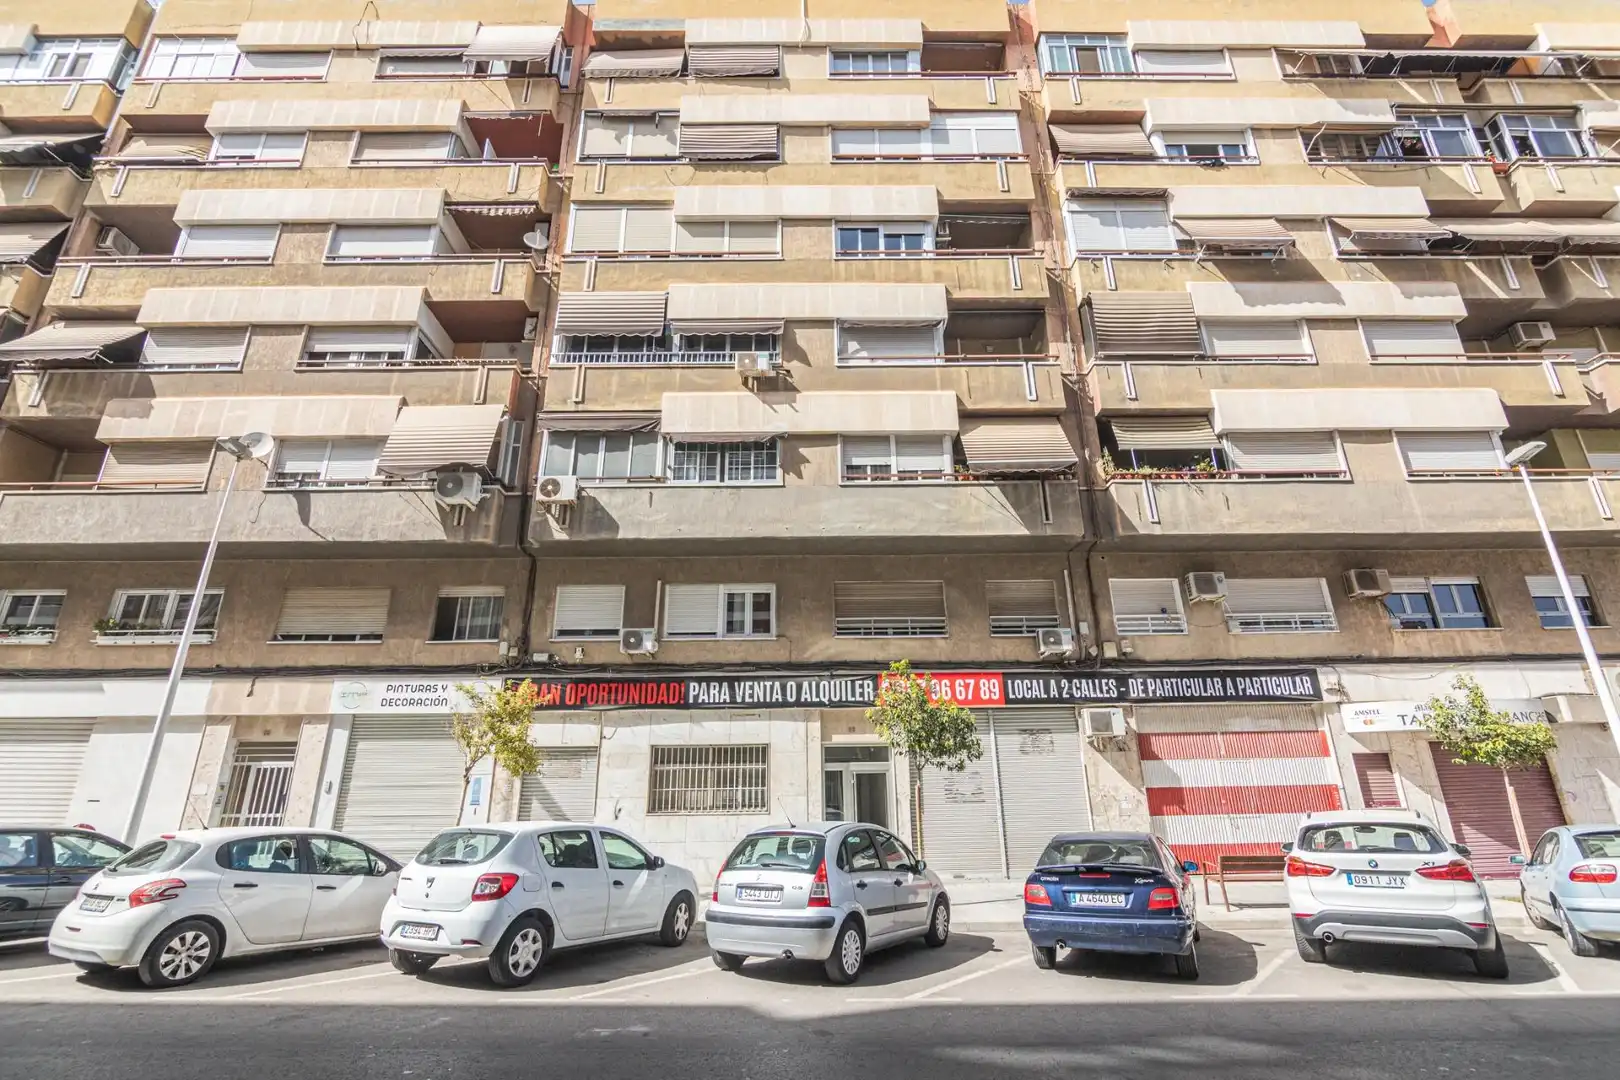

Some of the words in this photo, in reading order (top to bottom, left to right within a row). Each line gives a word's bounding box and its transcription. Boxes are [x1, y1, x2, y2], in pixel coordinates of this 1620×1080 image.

[386, 684, 438, 693] PINTURAS
[441, 684, 448, 692] Y
[565, 682, 685, 705] OPORTUNIDAD!
[689, 681, 730, 704] PARA
[735, 681, 783, 702] VENTA
[787, 681, 797, 702] O
[801, 680, 874, 704] ALQUILER
[955, 679, 975, 700] 67
[980, 679, 1000, 700] 89
[1007, 679, 1047, 698] LOCAL
[1050, 679, 1059, 698] A
[1061, 679, 1069, 698] 2
[1072, 678, 1118, 698] CALLES
[1128, 678, 1147, 697] DE
[1148, 677, 1224, 697] PARTICULAR
[1226, 677, 1235, 696] A
[1236, 676, 1313, 696] PARTICULAR
[381, 695, 448, 707] DECORACIÓN
[1354, 708, 1381, 716] AMSTEL
[1354, 875, 1381, 885] 0911
[1386, 876, 1407, 886] JYX
[744, 888, 761, 898] 5443
[1078, 893, 1085, 903] A
[1086, 893, 1109, 904] 4640
[1111, 894, 1123, 904] EC
